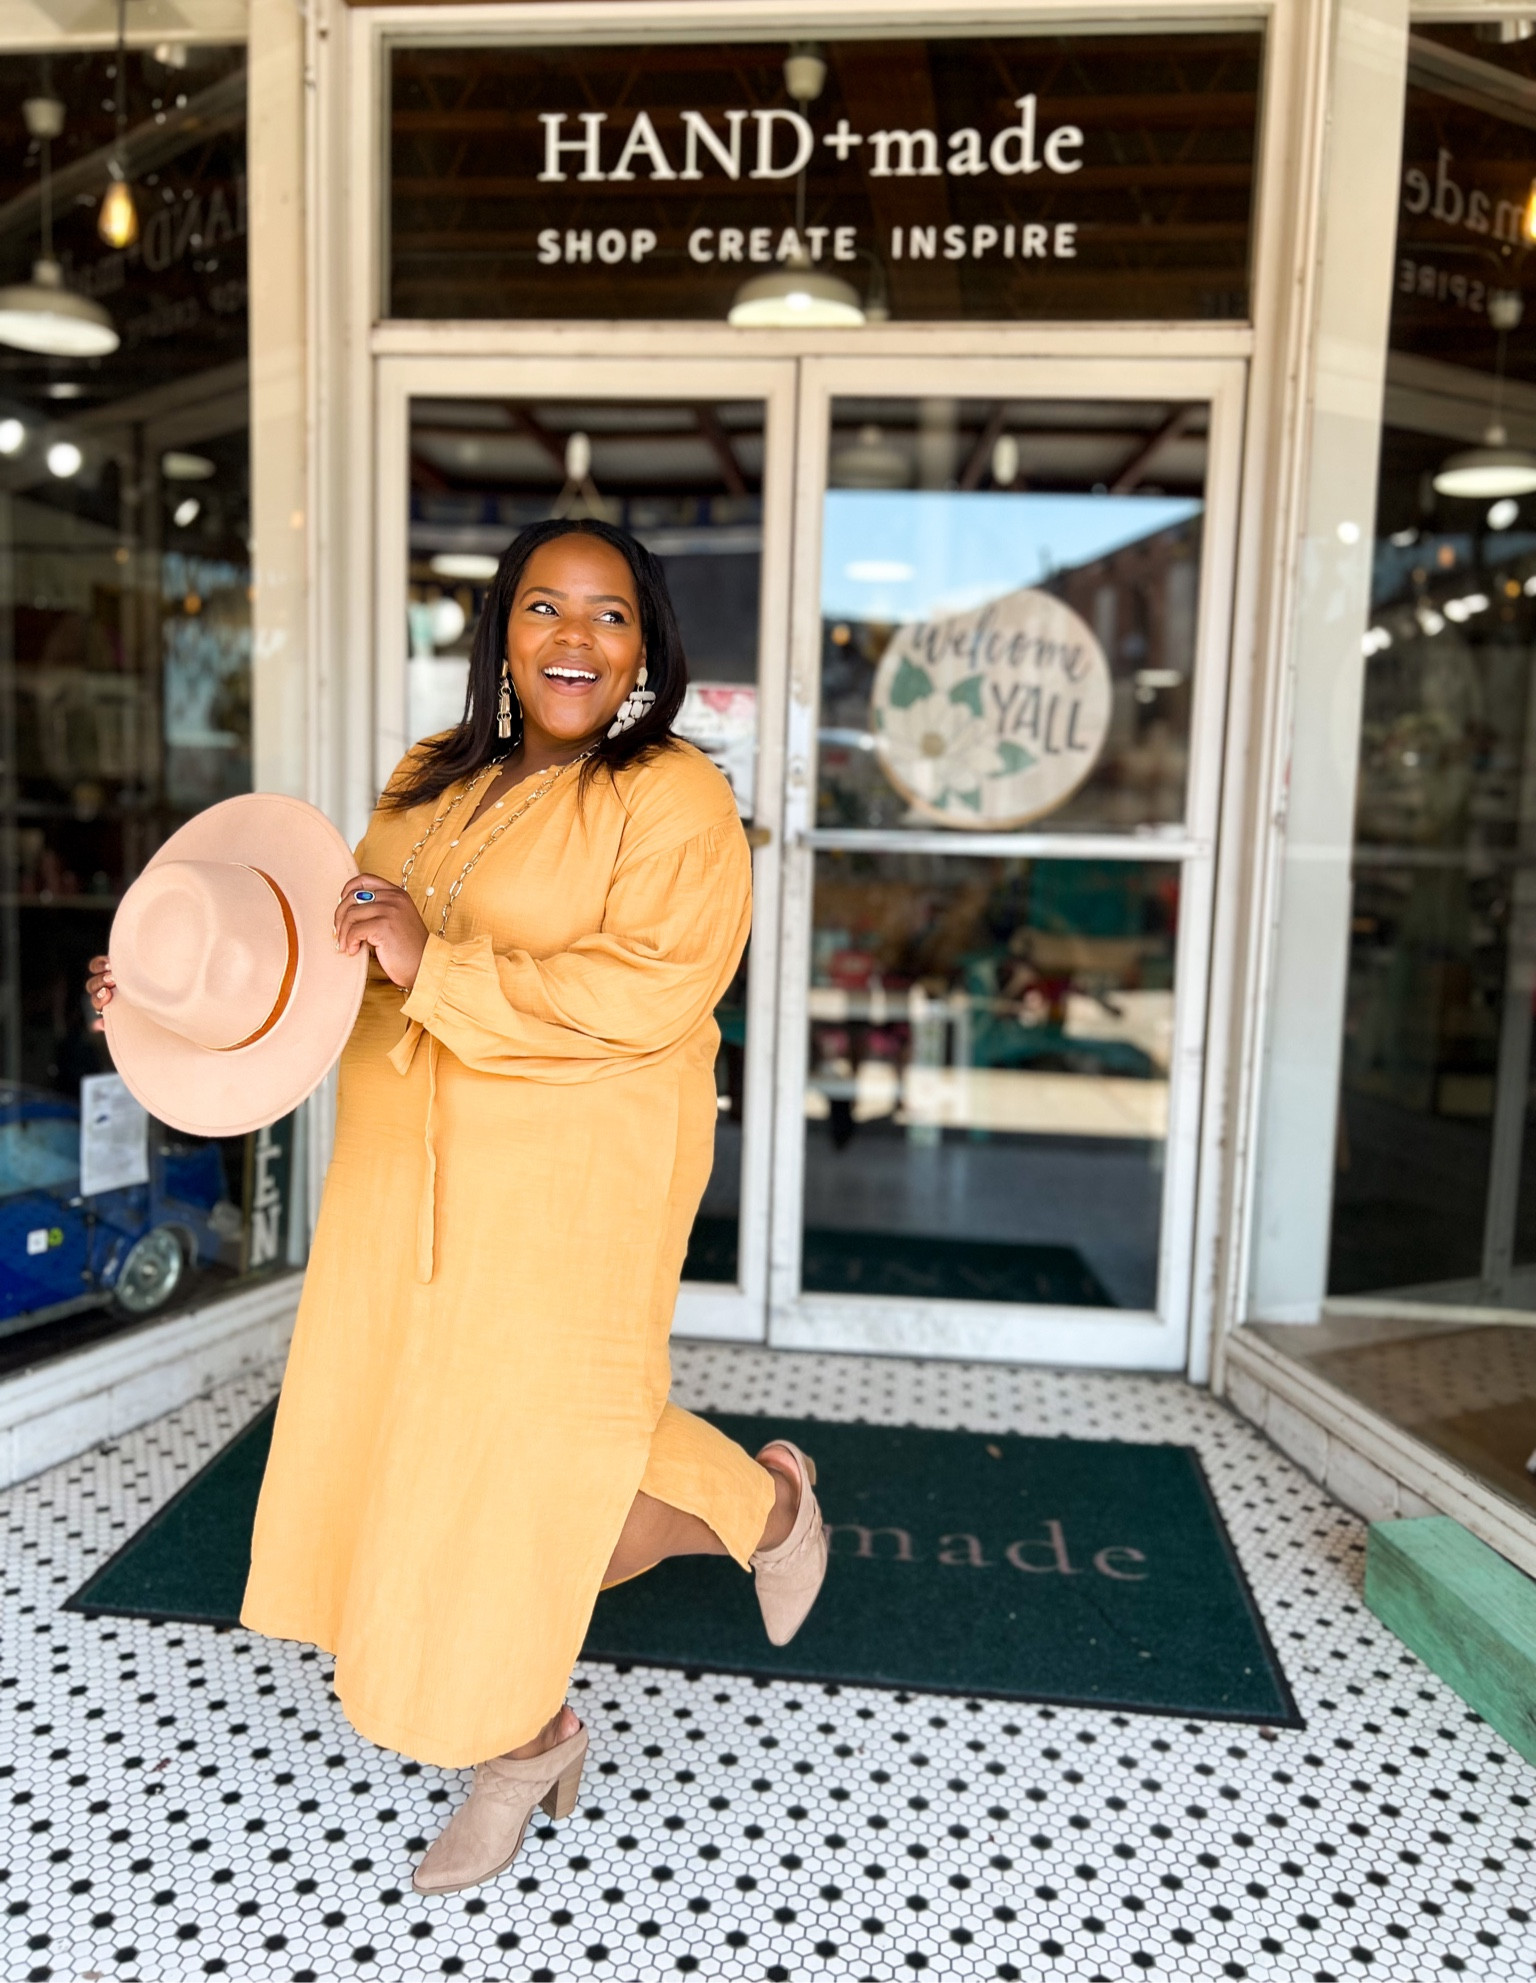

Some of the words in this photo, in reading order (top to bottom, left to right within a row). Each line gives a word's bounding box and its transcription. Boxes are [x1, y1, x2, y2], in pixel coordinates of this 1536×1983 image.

[537, 228, 658, 264] SHOP
[688, 225, 858, 262] CREATE
[891, 222, 1078, 260] INSPIRE
[822, 1519, 1151, 1581] made
